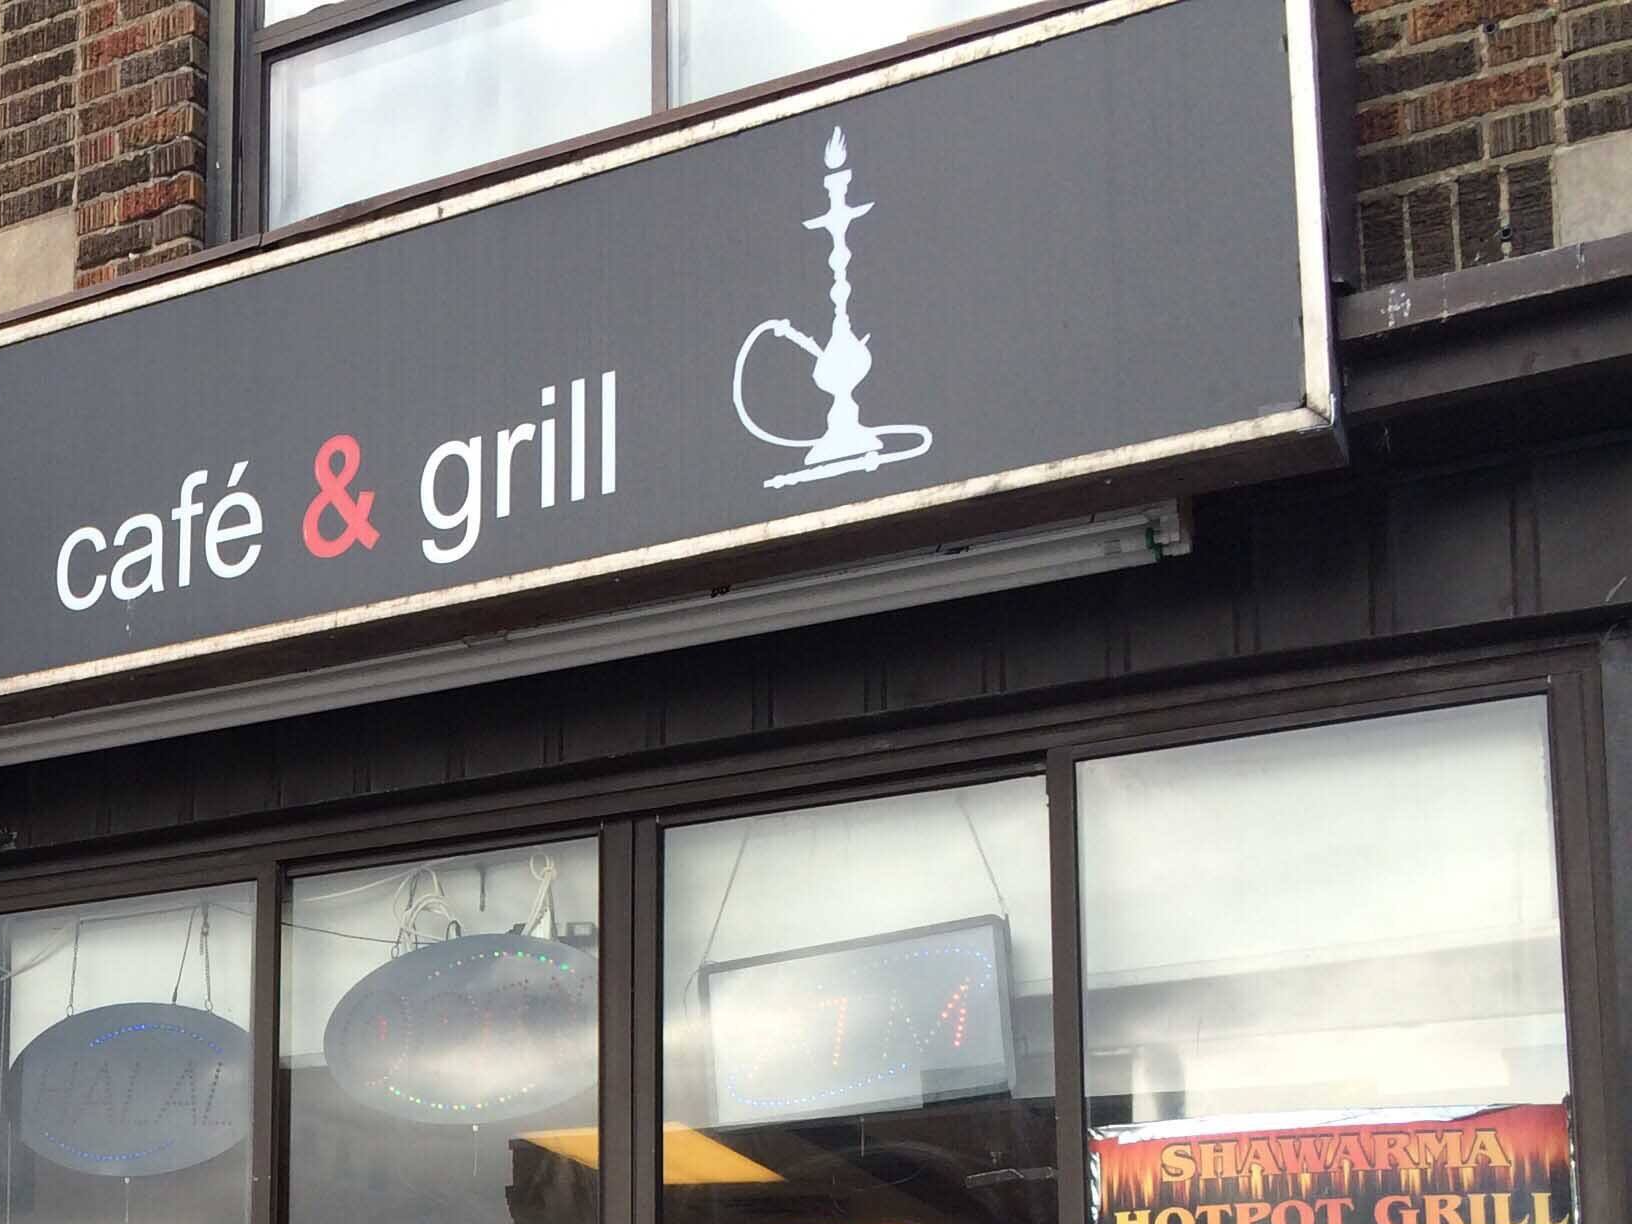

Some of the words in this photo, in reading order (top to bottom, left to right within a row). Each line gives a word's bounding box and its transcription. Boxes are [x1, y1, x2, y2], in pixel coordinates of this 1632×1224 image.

[56, 460, 264, 611] café
[302, 433, 380, 559] &
[419, 370, 617, 563] grill
[1160, 1127, 1511, 1182] SHAWARMA
